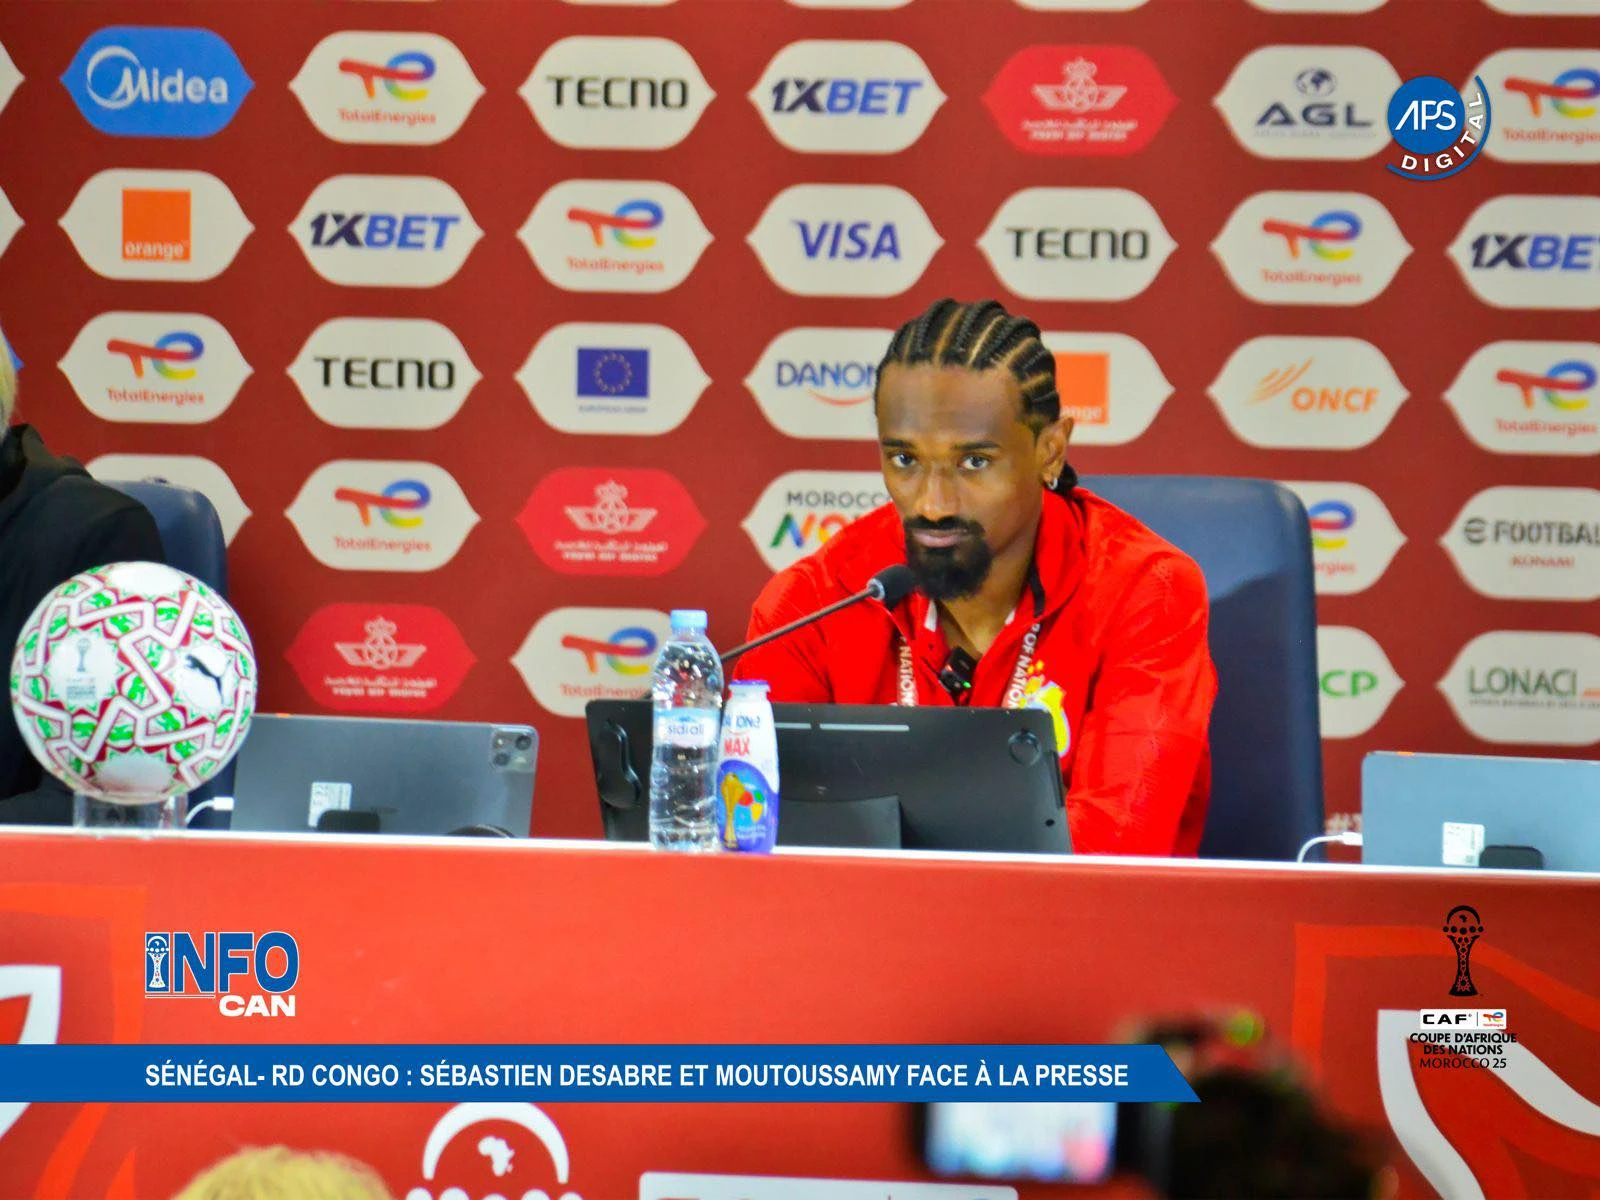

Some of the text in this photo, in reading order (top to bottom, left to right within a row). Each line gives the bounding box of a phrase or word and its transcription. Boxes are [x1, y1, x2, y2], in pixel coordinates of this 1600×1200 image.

[547, 76, 689, 110] TECNO
[771, 78, 923, 116] 1XBET
[339, 108, 438, 127] TotalEnergies
[1256, 102, 1374, 128] AGL
[310, 213, 460, 251] 1XBET
[795, 221, 901, 260] VISA
[1006, 227, 1149, 261] TECNO
[125, 241, 184, 261] orange
[1471, 234, 1600, 270] 1XBE
[566, 256, 665, 275] TotalEnergies
[1262, 269, 1363, 287] TotalEnergies
[314, 356, 456, 391] TECNO
[107, 388, 206, 406] TotalEnergies
[1291, 387, 1380, 414] ONCF
[1496, 420, 1598, 438] TotalEnergies
[787, 491, 892, 508] MOROCC
[334, 537, 433, 554] TotalEnergies
[1469, 667, 1577, 697] LONACI
[723, 737, 750, 757] MAX
